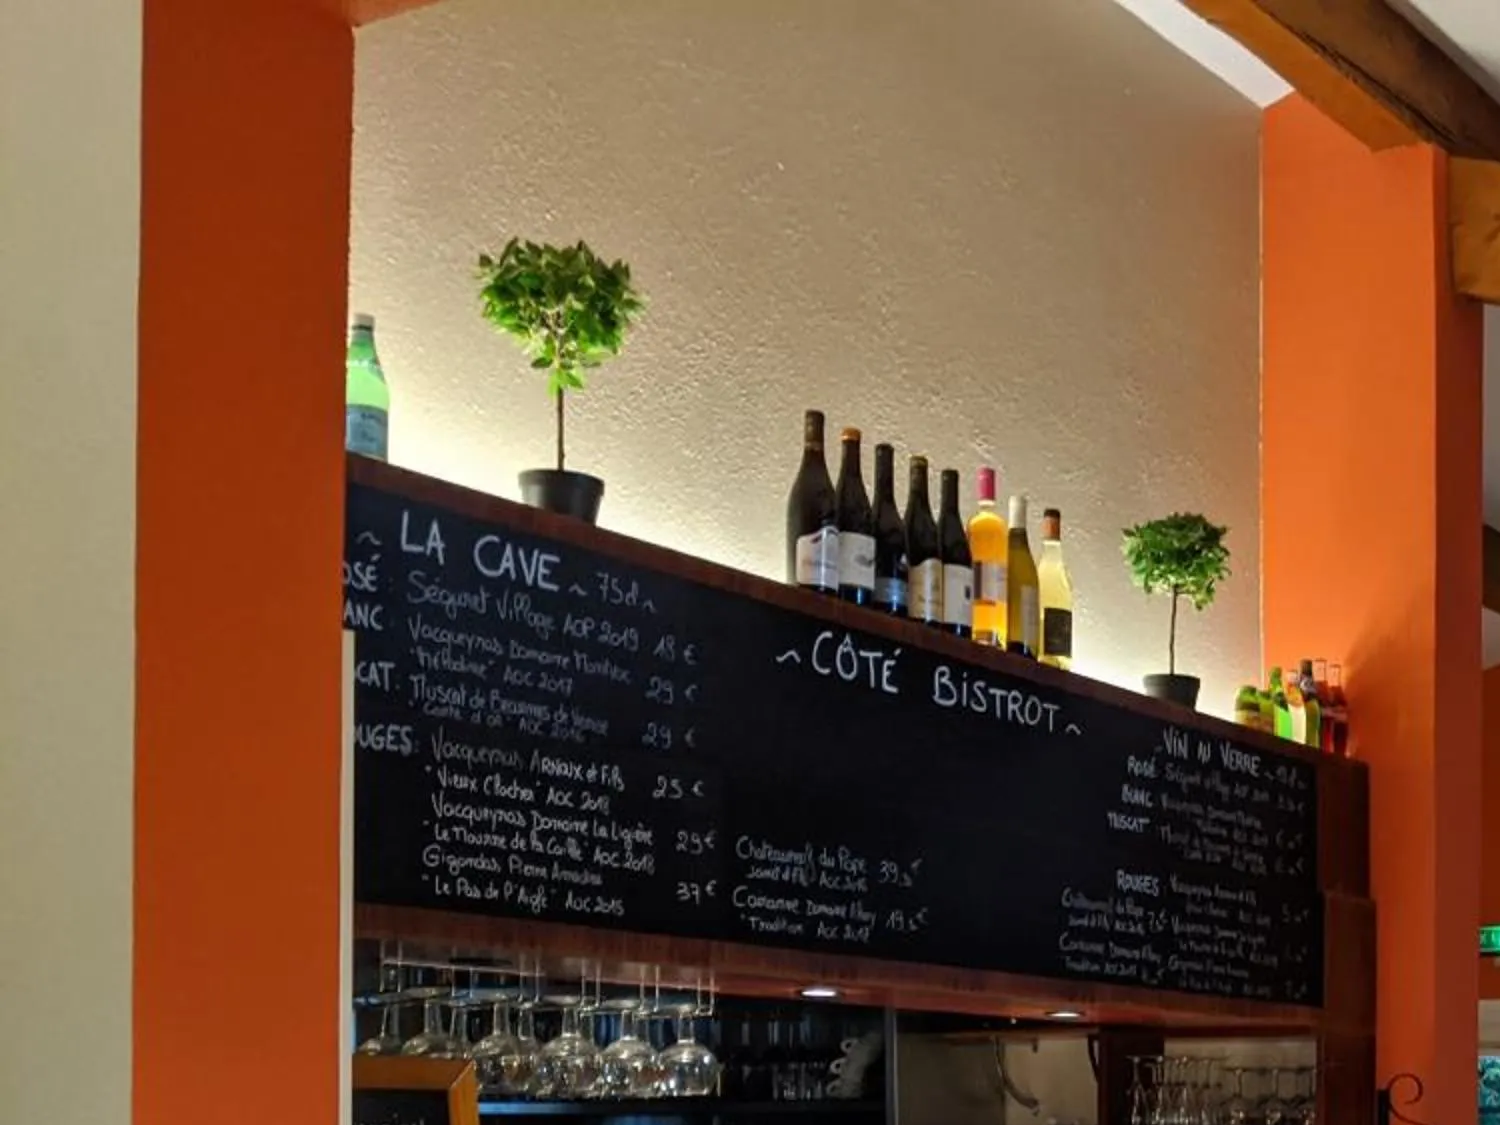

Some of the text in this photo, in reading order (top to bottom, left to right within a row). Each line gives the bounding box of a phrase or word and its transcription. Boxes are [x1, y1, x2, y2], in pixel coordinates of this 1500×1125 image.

[401, 508, 447, 567] LA
[472, 533, 561, 593] CAVE
[812, 631, 902, 694] CÔTÉ
